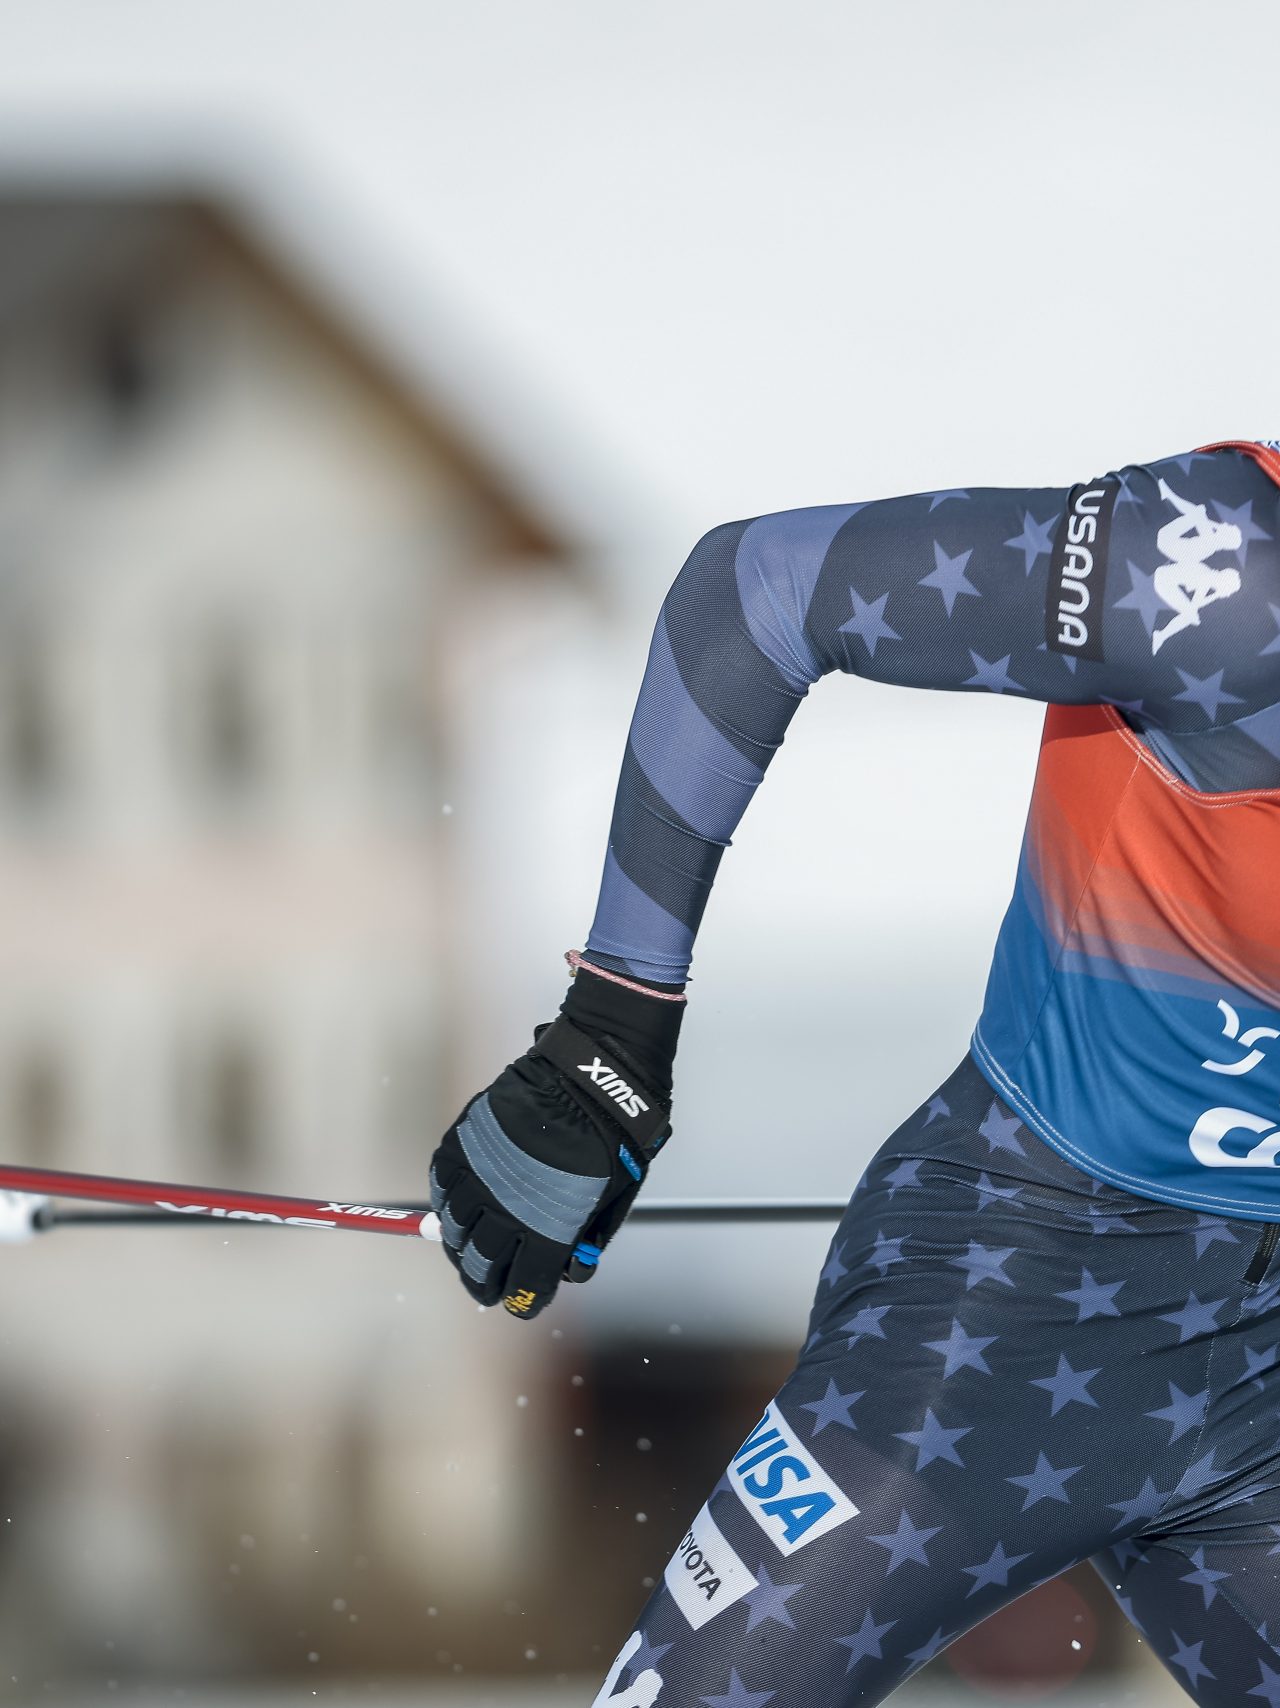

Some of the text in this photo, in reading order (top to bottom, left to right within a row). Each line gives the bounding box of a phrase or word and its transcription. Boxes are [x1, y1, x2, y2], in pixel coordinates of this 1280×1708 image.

[1058, 489, 1105, 647] USANA
[577, 1056, 650, 1118] SWIX
[734, 1408, 837, 1545] VISA
[679, 1527, 722, 1601] OYOTA
